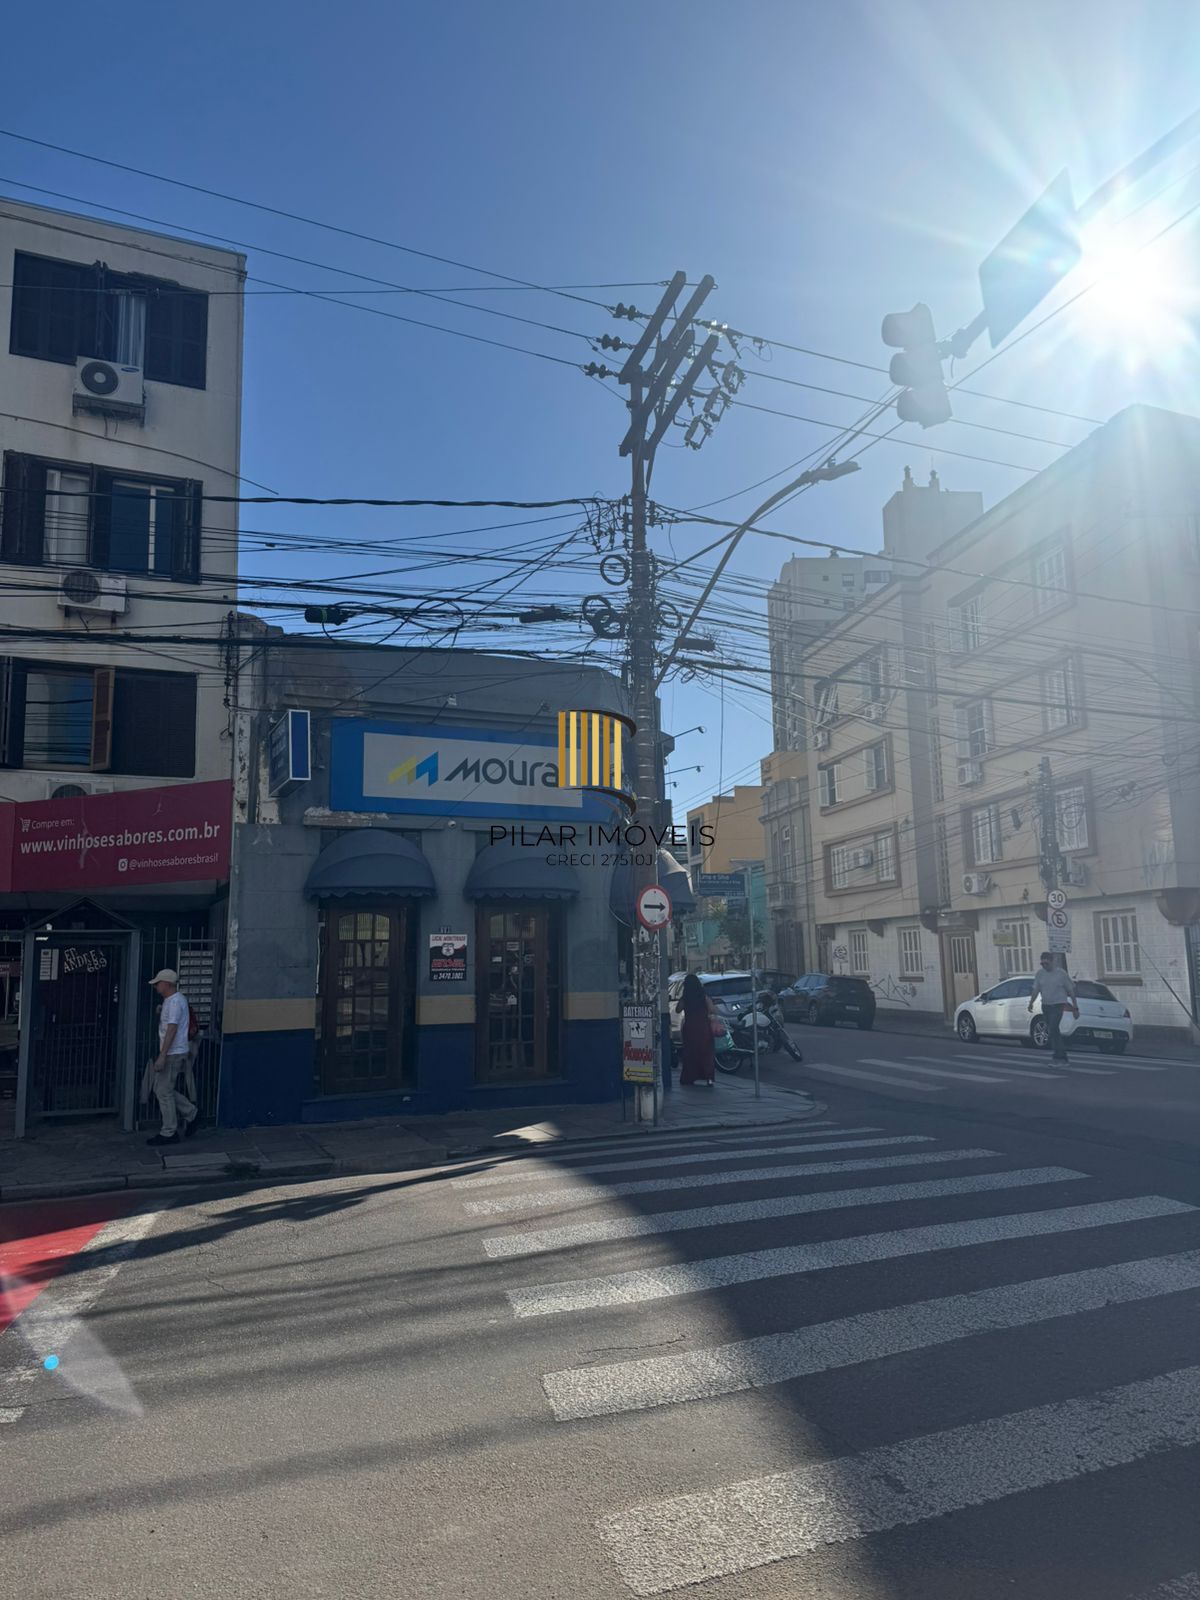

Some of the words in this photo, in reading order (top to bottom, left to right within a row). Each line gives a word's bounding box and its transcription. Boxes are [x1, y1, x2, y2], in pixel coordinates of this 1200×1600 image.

[31, 818, 60, 830] Compre
[60, 817, 75, 828] em:
[20, 821, 220, 854] www.vinhosesabores.com.br
[129, 852, 219, 871] @vinhosesaboresbrasil
[1050, 893, 1064, 903] 30
[623, 1006, 653, 1018] BATERIAS
